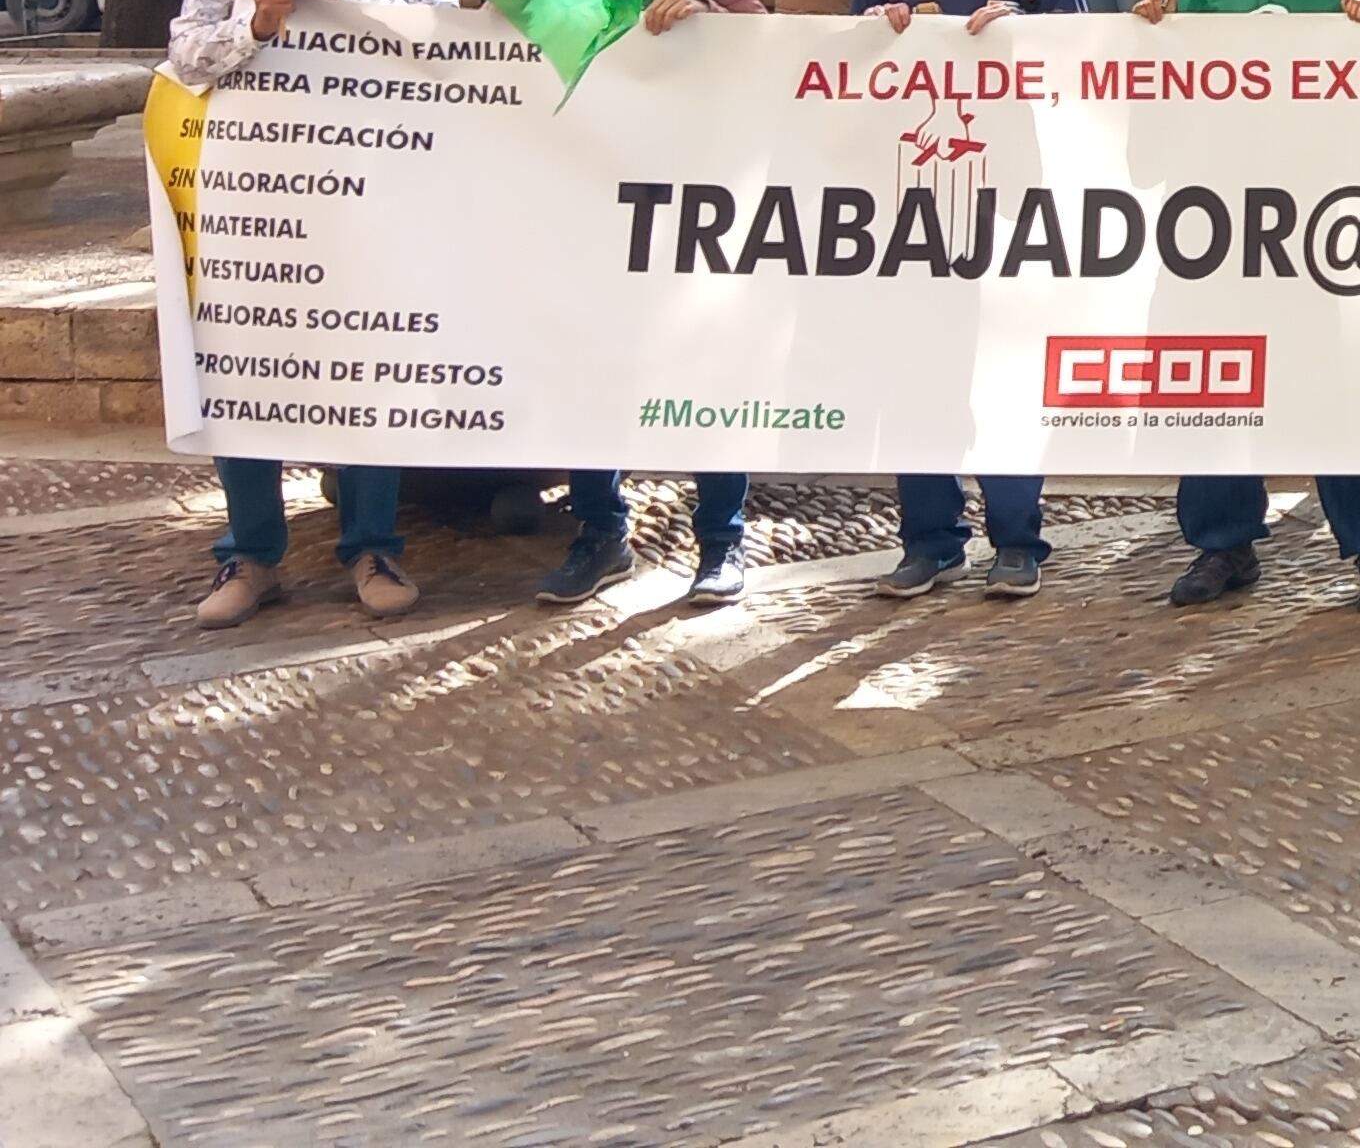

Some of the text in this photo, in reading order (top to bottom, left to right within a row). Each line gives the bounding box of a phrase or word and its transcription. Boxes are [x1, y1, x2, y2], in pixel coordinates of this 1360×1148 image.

[412, 41, 543, 63] FAMILIAR
[321, 75, 523, 106] PROFESIONAL
[795, 59, 1060, 107] ALCALDE,
[1080, 59, 1272, 101] MENOS
[180, 118, 434, 151] SIN RECLASIFICACIÓN
[168, 167, 366, 197] SIN VALORACIÓN
[176, 211, 308, 240] IN MATERIAL
[200, 256, 325, 285] VESTUARIO
[196, 302, 440, 334] MEJORAS SOCIALES
[194, 351, 504, 387] PROVISIÓN DE PUESTOS
[1058, 348, 1254, 395] CCOO
[201, 397, 506, 432] NSTALACIONES DIGNAS
[638, 398, 846, 431] #Movilizate
[1040, 410, 1264, 429] servicios a la ciudadanía
